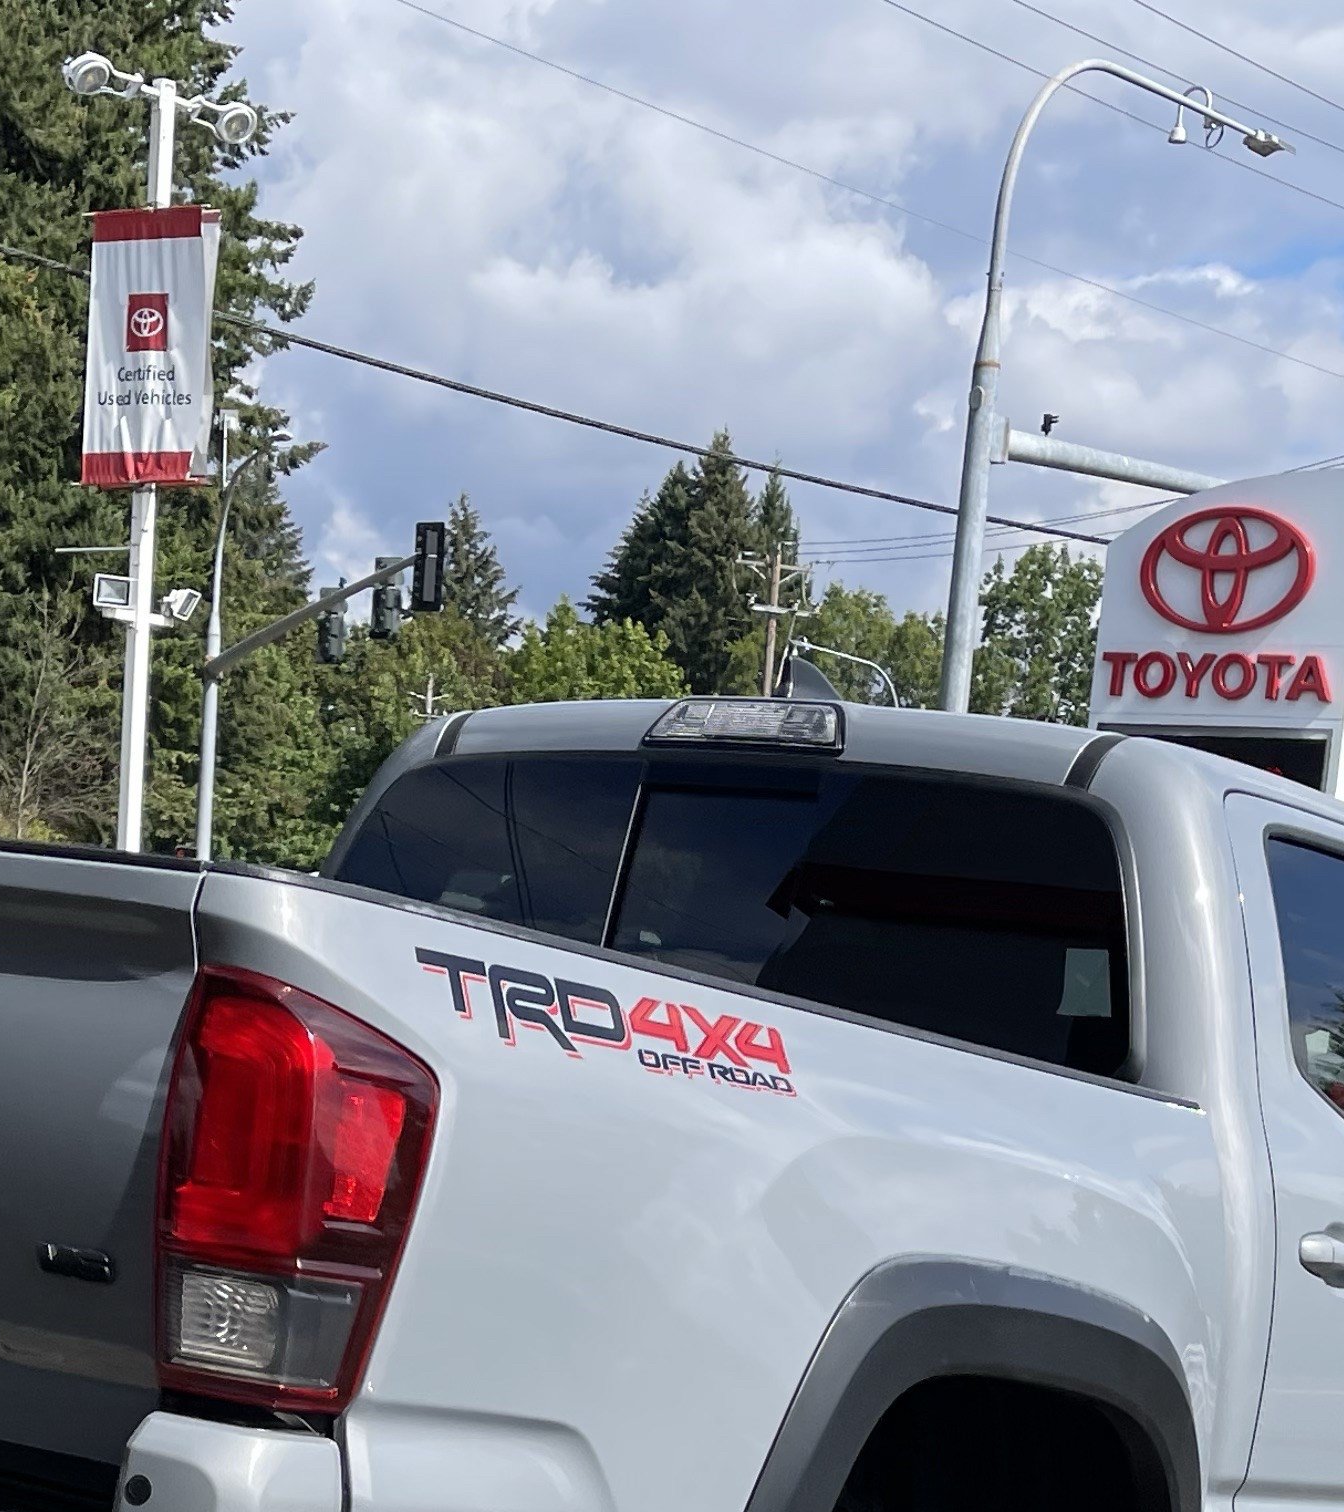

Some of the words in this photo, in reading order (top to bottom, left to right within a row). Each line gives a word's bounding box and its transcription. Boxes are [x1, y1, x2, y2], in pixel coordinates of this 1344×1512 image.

[97, 388, 132, 407] Used
[134, 388, 193, 407] Vehicles
[117, 364, 176, 383] Certified
[1101, 650, 1333, 705] TOYOTA
[414, 946, 633, 1059] TRD
[637, 1048, 704, 1079] OFF
[706, 1061, 798, 1097] ROAD
